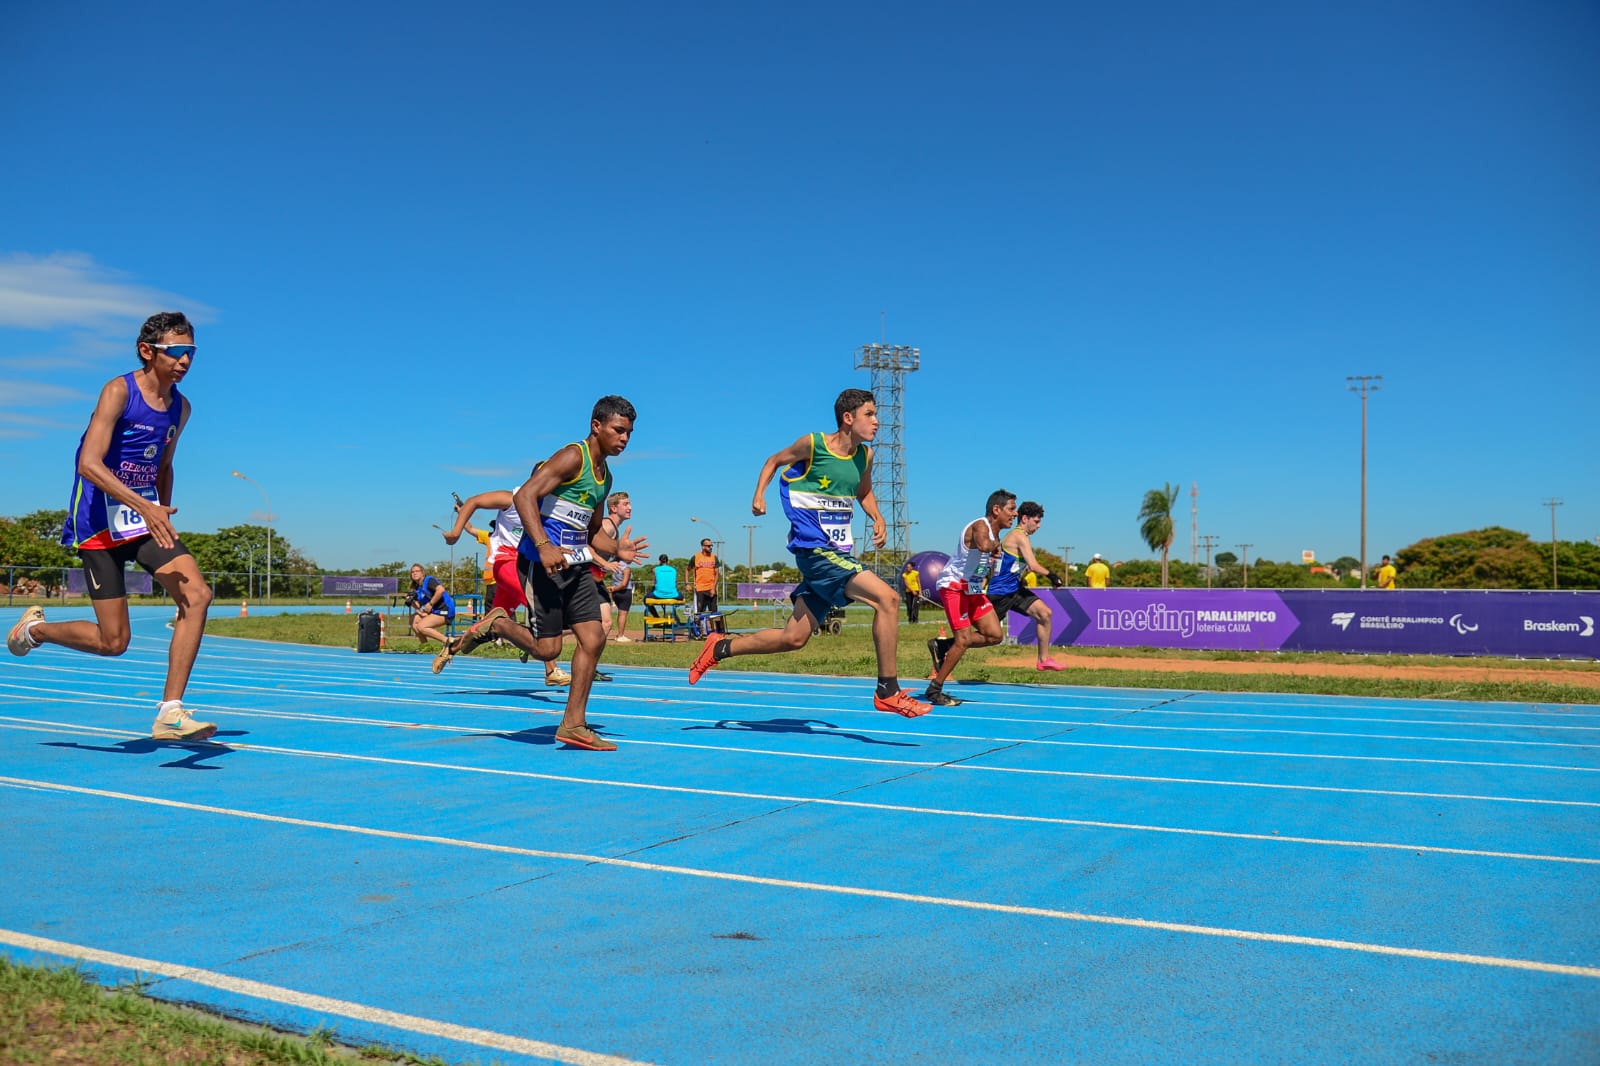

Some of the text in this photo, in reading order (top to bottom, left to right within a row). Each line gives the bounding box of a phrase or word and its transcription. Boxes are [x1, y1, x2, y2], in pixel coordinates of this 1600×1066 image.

[1097, 603, 1195, 638] meeting
[1360, 615, 1390, 623] COMITÊ
[1196, 623, 1251, 633] loterias CAIXA
[1360, 622, 1405, 630] BRASILEIRO
[1523, 619, 1580, 632] Braskem
